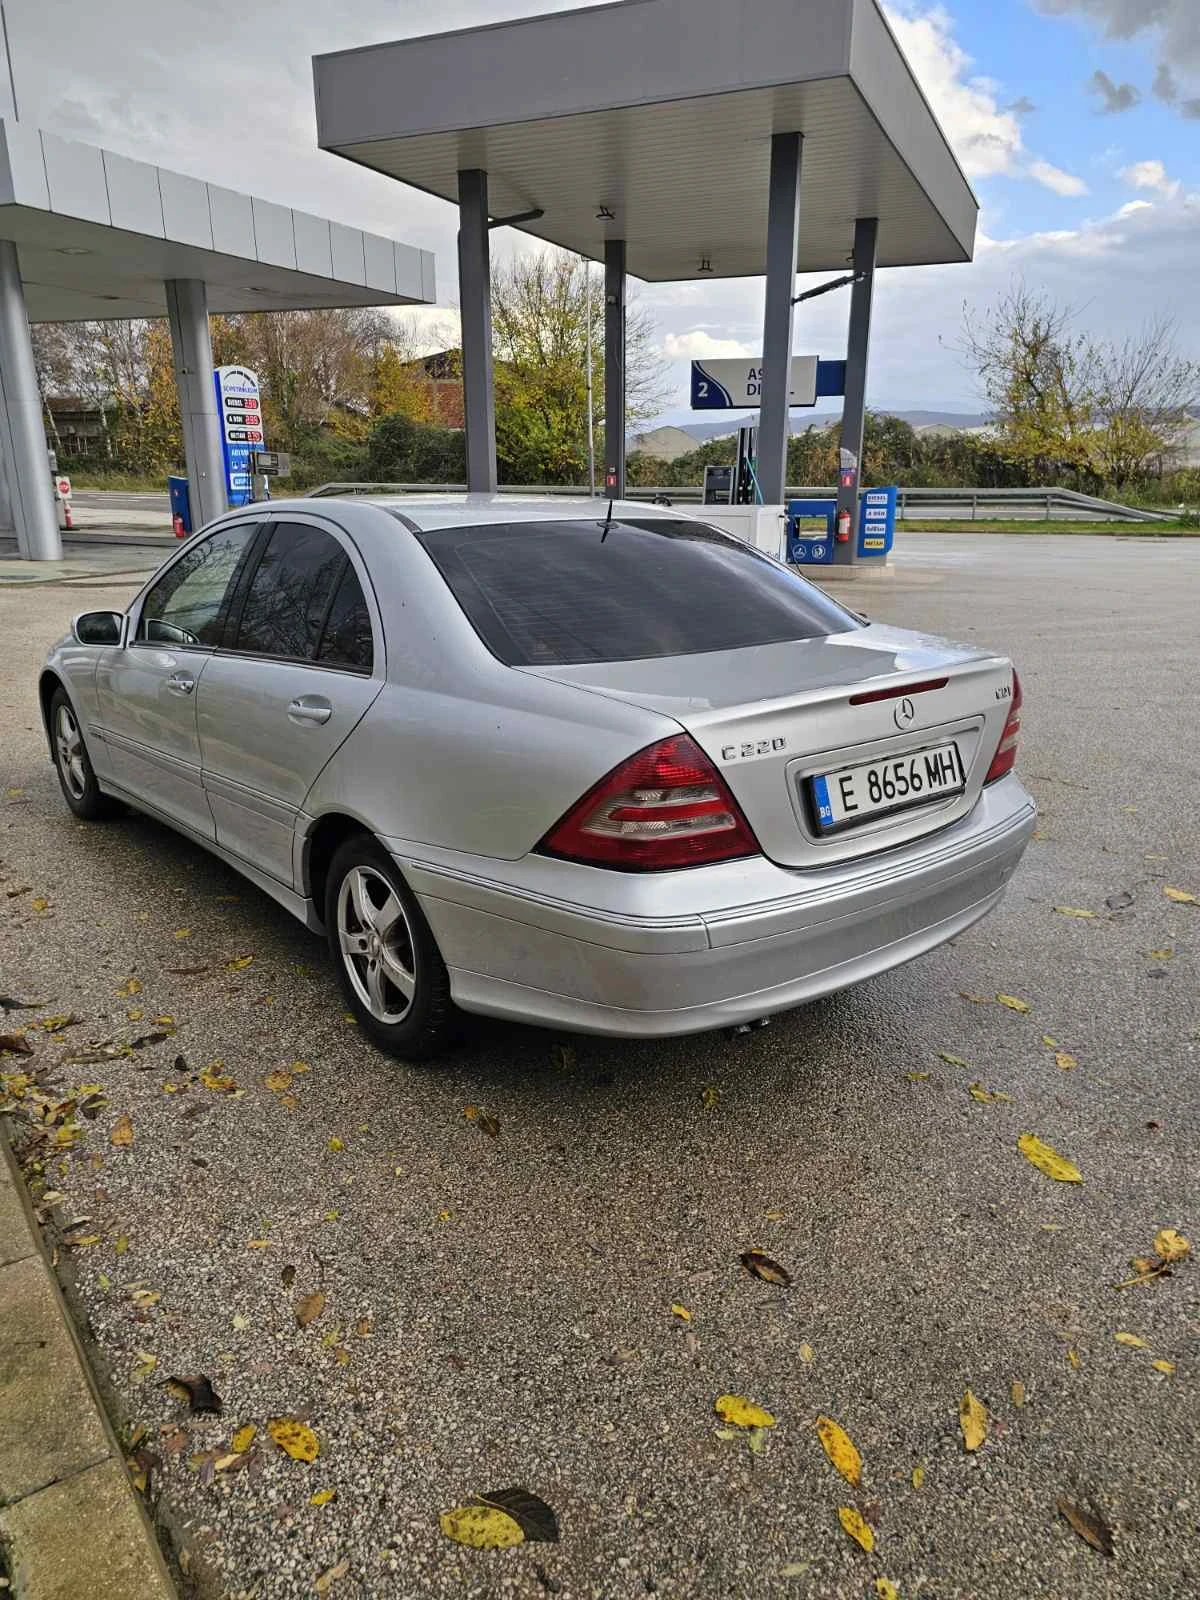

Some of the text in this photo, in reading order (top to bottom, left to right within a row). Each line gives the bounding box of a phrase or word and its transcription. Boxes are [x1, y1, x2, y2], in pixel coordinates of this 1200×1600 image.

[698, 382, 709, 397] 2
[721, 737, 786, 761] C 220
[838, 749, 957, 812] E 8656 MH
[819, 806, 831, 818] BG
